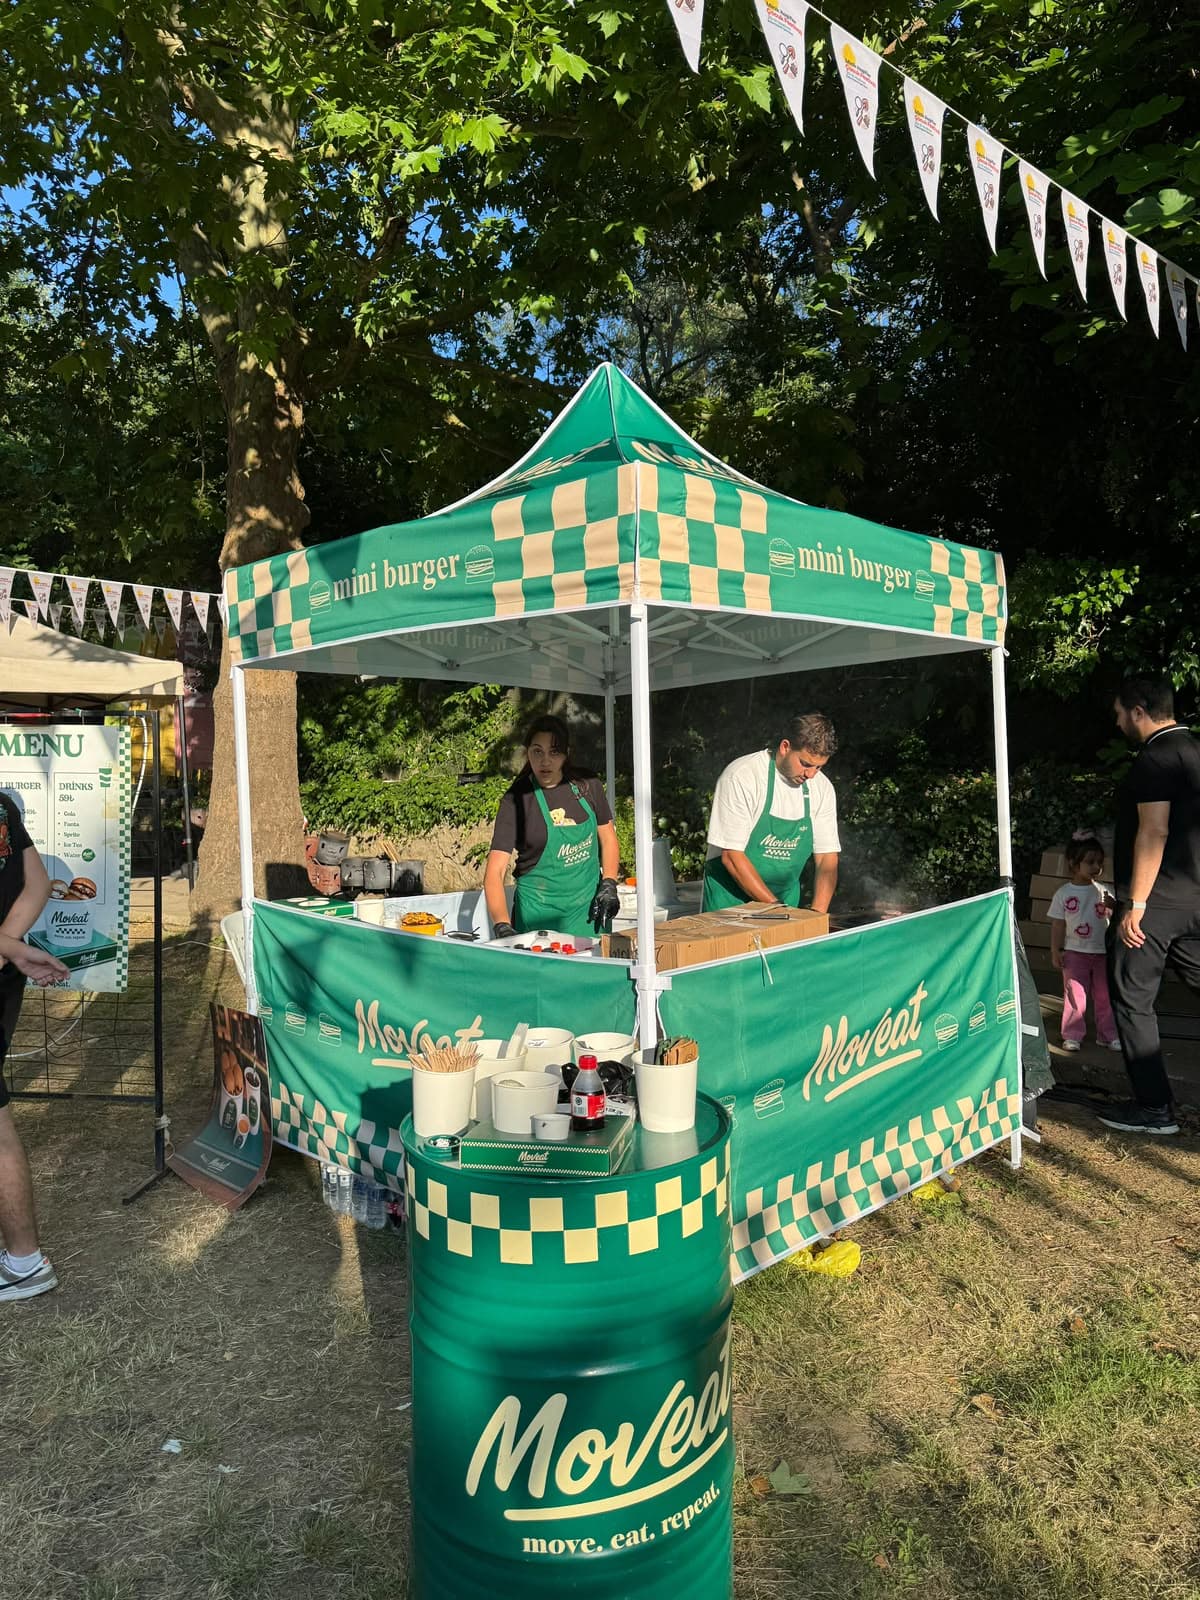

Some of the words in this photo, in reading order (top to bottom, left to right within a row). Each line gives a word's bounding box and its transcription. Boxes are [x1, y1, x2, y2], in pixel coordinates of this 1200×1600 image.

[332, 562, 378, 601] mini
[383, 554, 461, 591] burger
[798, 542, 845, 576] mini
[848, 549, 912, 593] burger
[0, 733, 84, 758] MENU
[5, 782, 42, 790] BURGER
[51, 911, 90, 925] Moveat
[803, 980, 928, 1101] Moveat
[518, 1151, 549, 1163] Moveat
[465, 1315, 731, 1499] Moveat
[522, 1535, 603, 1554] move.
[610, 1522, 656, 1550] eat.
[661, 1480, 720, 1536] repeat.
